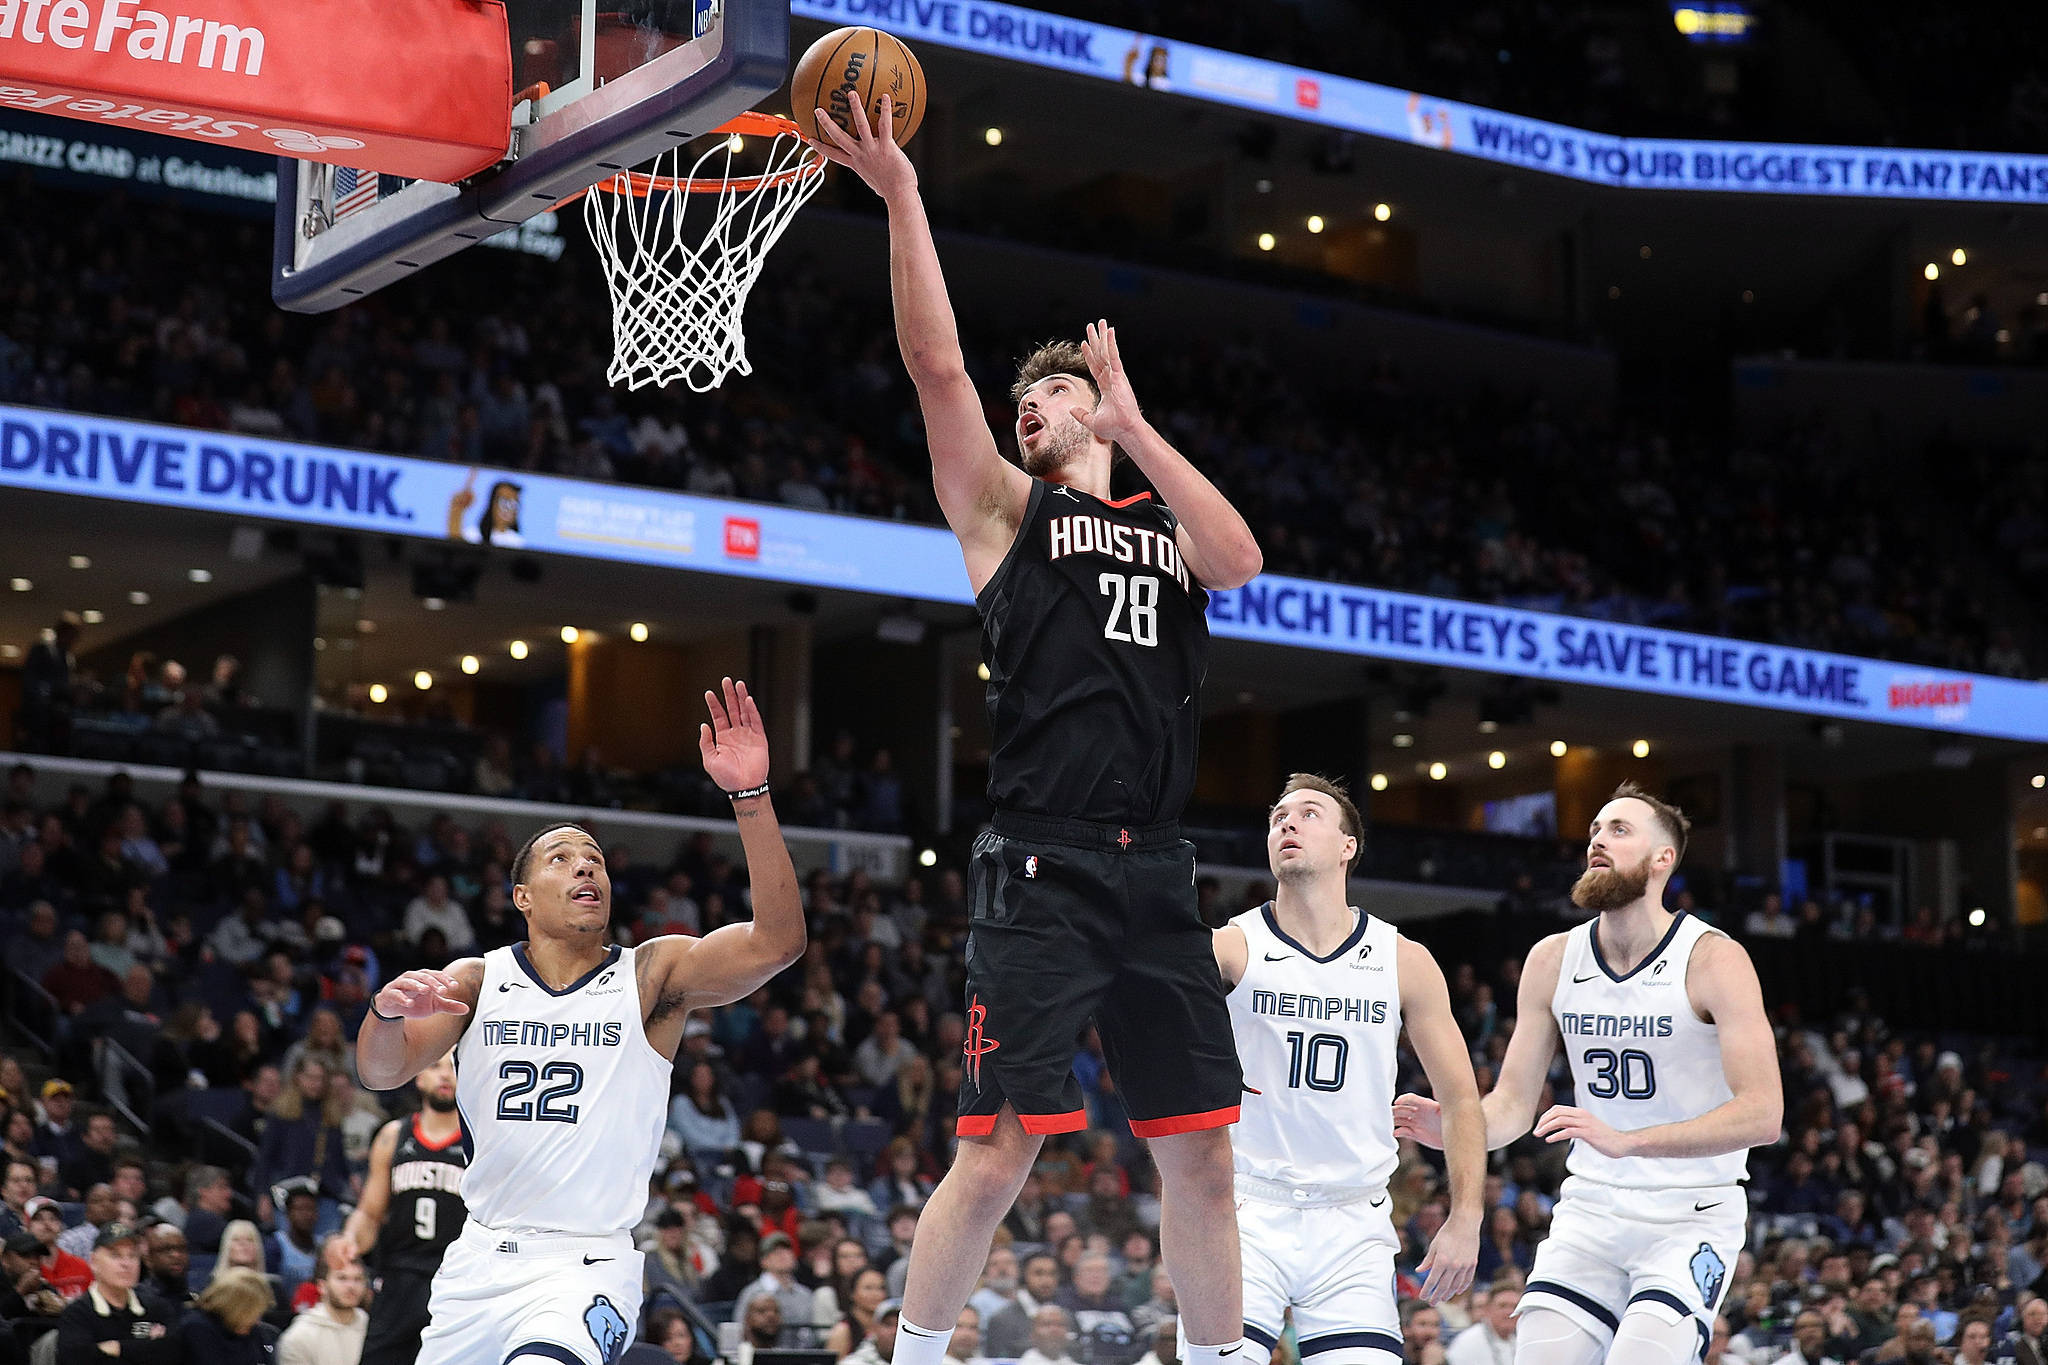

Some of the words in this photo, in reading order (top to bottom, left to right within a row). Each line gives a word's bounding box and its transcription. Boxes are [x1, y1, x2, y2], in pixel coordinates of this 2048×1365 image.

[94, 0, 265, 76] Farm
[66, 98, 259, 138] State
[67, 141, 135, 179] CARD
[1585, 141, 1684, 179] YOUR
[1693, 154, 1855, 185] BIGGEST
[1865, 158, 1951, 190] FAN?
[0, 421, 186, 490] DRIVE
[200, 446, 414, 521] DRUNK.
[1050, 515, 1190, 596] HOUSTON
[1098, 572, 1159, 648] 28
[1210, 583, 1331, 635] ENCH
[1340, 597, 1422, 647] THE
[1557, 626, 1659, 679] SAVE
[1666, 642, 1739, 689] THE
[1747, 654, 1869, 707] GAME.
[1252, 989, 1388, 1024] MEMPHIS
[1562, 1012, 1673, 1038] MEMPHIS
[483, 1020, 622, 1047] MEMPHIS
[1287, 1031, 1349, 1092] 10
[1584, 1048, 1656, 1100] 30
[496, 1060, 584, 1124] 22
[414, 1197, 437, 1240] 9
